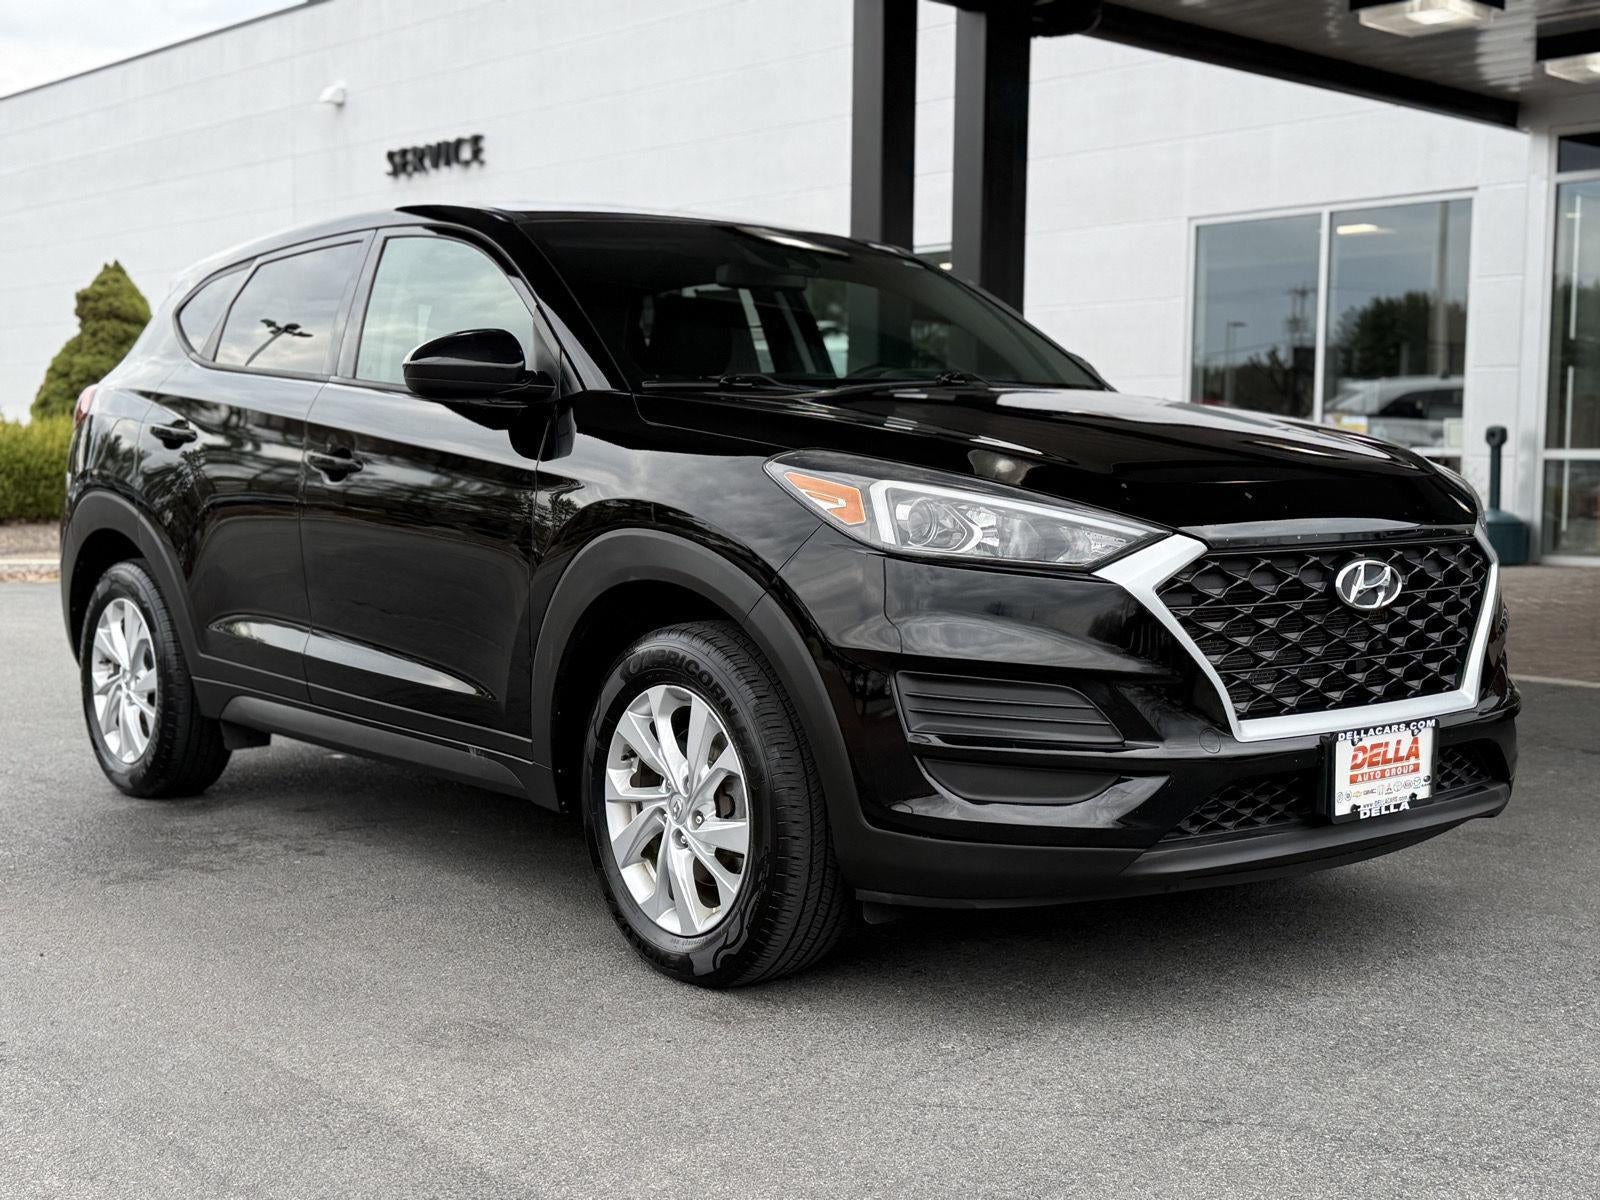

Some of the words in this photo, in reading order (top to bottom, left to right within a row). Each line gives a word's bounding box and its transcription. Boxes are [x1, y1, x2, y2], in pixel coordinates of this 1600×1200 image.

[386, 134, 484, 178] SERVICE
[1338, 719, 1436, 741] DELLACARS.COM
[1350, 736, 1420, 771] DELLA
[1357, 771, 1382, 783] AUTO
[1385, 765, 1414, 777] GROUP
[1359, 801, 1410, 820] DELLA
